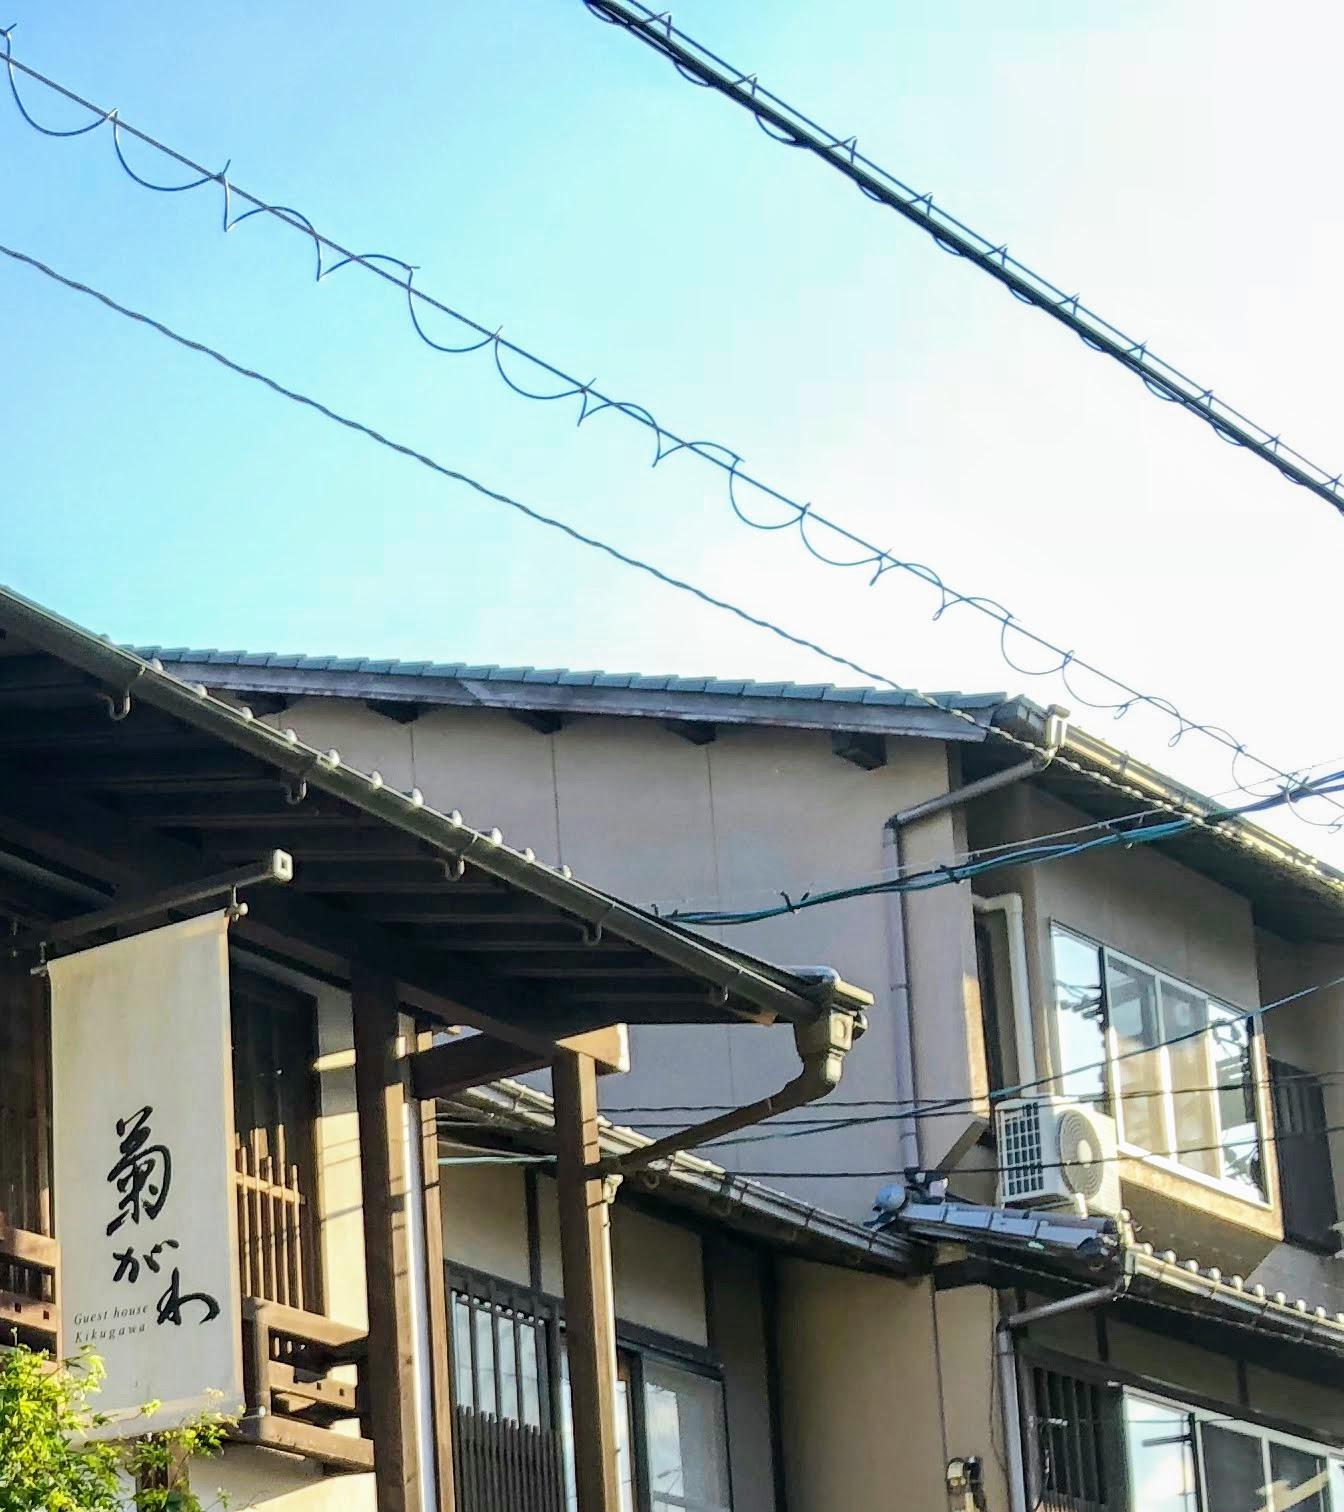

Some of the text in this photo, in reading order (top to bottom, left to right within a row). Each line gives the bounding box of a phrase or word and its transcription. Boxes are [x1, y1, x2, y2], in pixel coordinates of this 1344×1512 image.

[106, 1105, 221, 1326] 菊がわ
[74, 1305, 149, 1326] Guest house
[75, 1323, 145, 1343] Kikugawa
